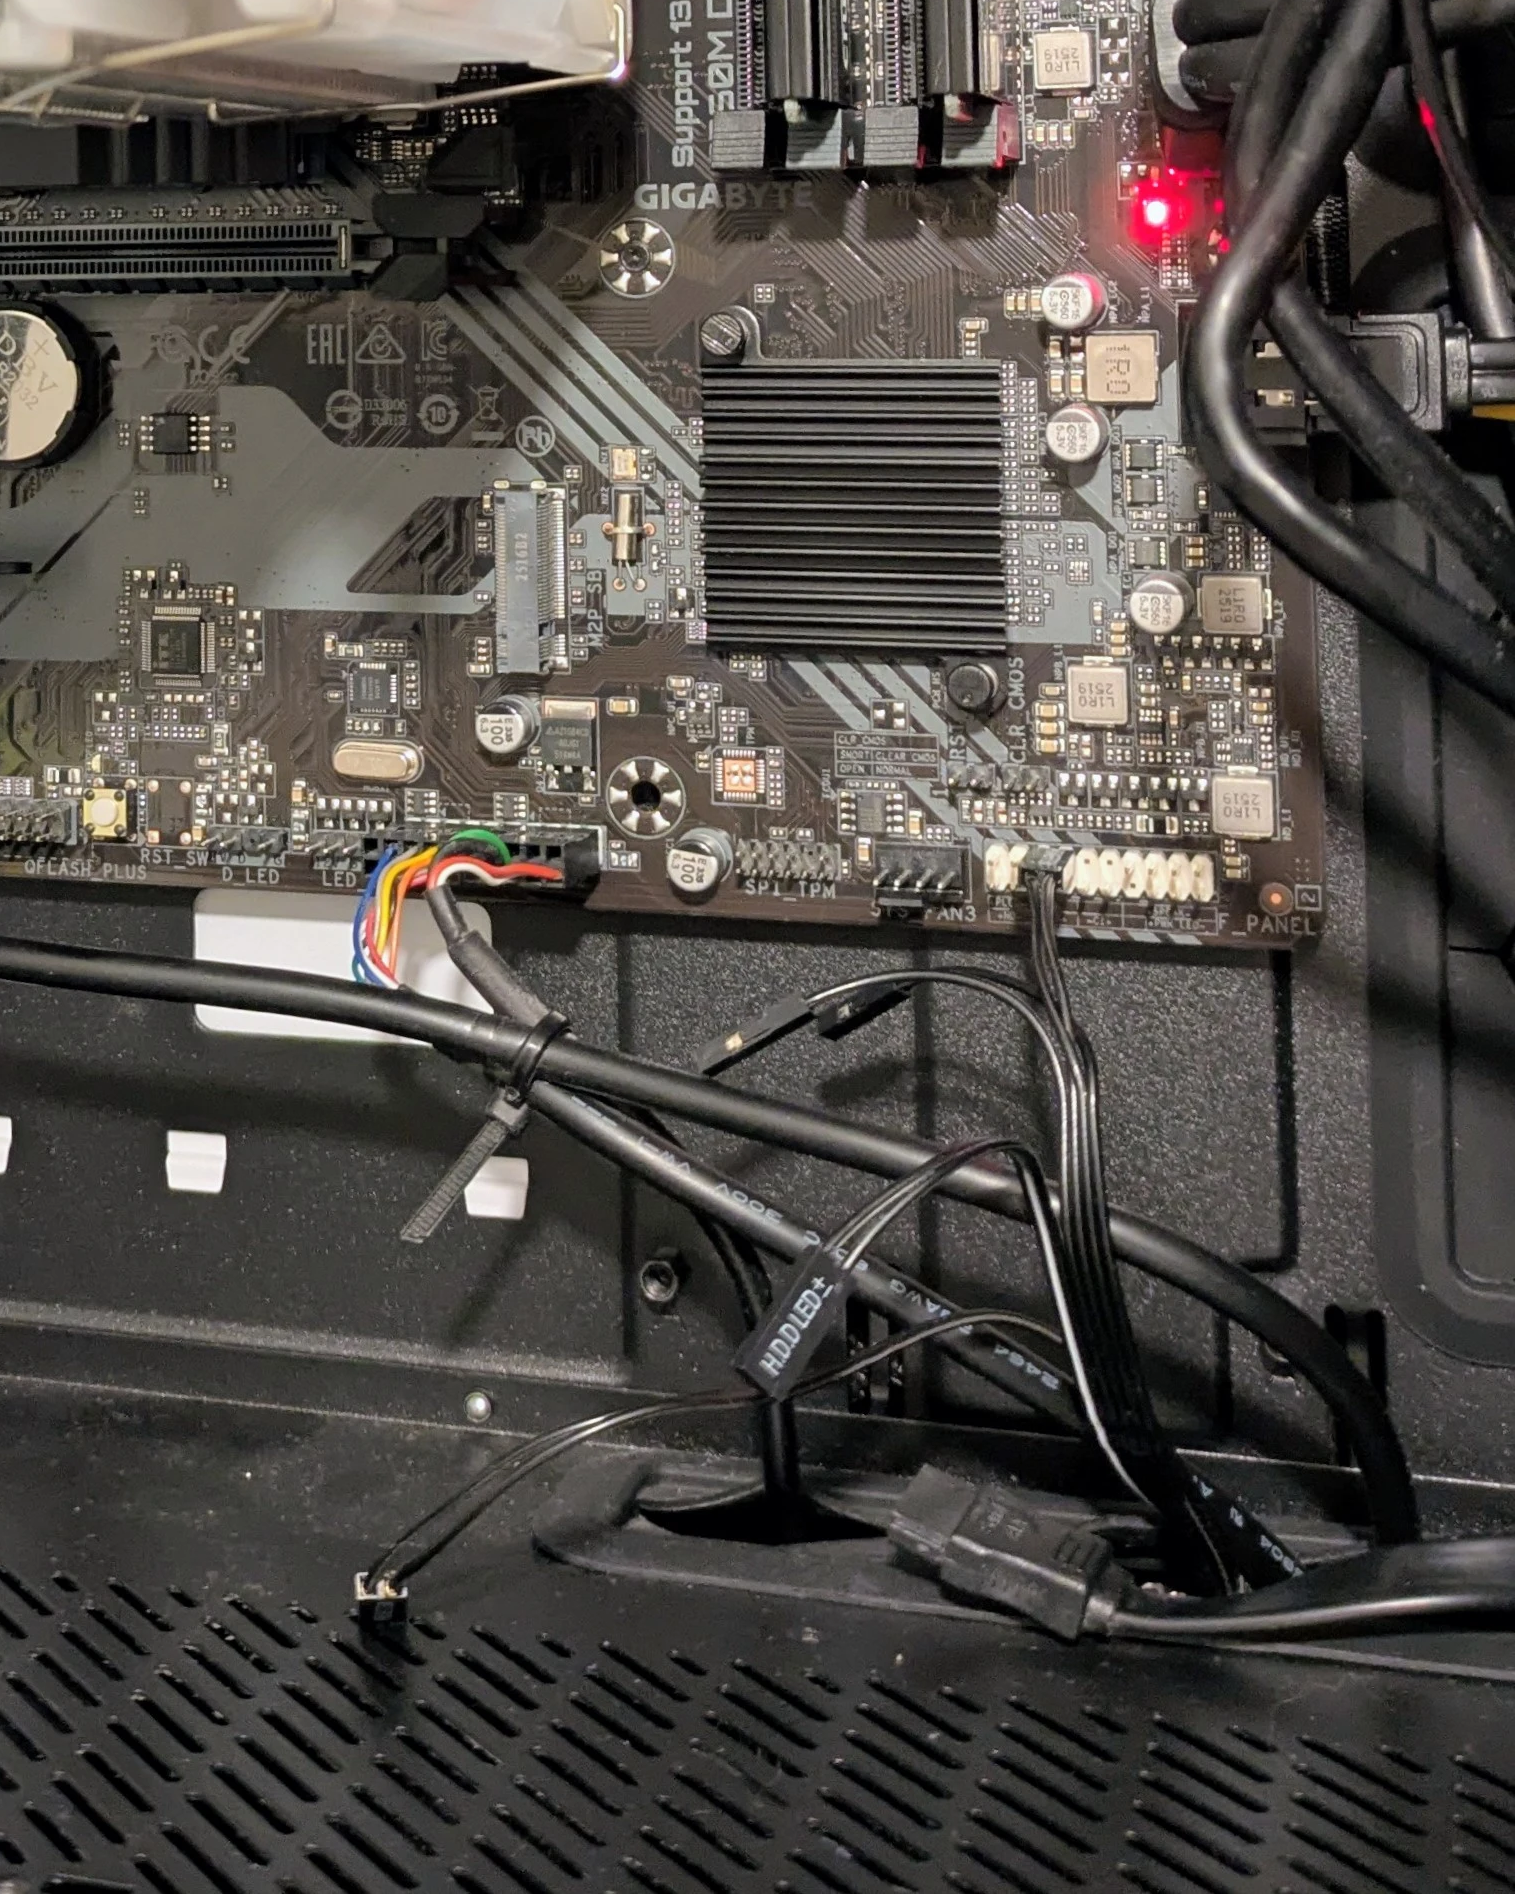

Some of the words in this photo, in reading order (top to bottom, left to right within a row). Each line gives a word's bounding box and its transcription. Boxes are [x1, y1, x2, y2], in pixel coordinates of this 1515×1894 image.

[671, 30, 697, 169] Support
[635, 182, 814, 211] GIGABYTE
[587, 570, 606, 647] M2P_SB
[1007, 656, 1031, 764] CLR_CMOS
[490, 718, 504, 745] 100
[840, 750, 869, 760] SHORT
[875, 750, 906, 761] CLEAR
[839, 763, 865, 774] OPEN
[875, 765, 912, 776] NORMAL
[24, 859, 147, 881] QFLASH_PLUS
[140, 847, 208, 870] RST_SW
[684, 854, 696, 884] 100
[222, 868, 280, 887] D_LED
[322, 870, 357, 888] LED
[744, 878, 836, 902] SPI_TPM
[1218, 912, 1316, 937] F_PANEL
[714, 1181, 784, 1226] 300V
